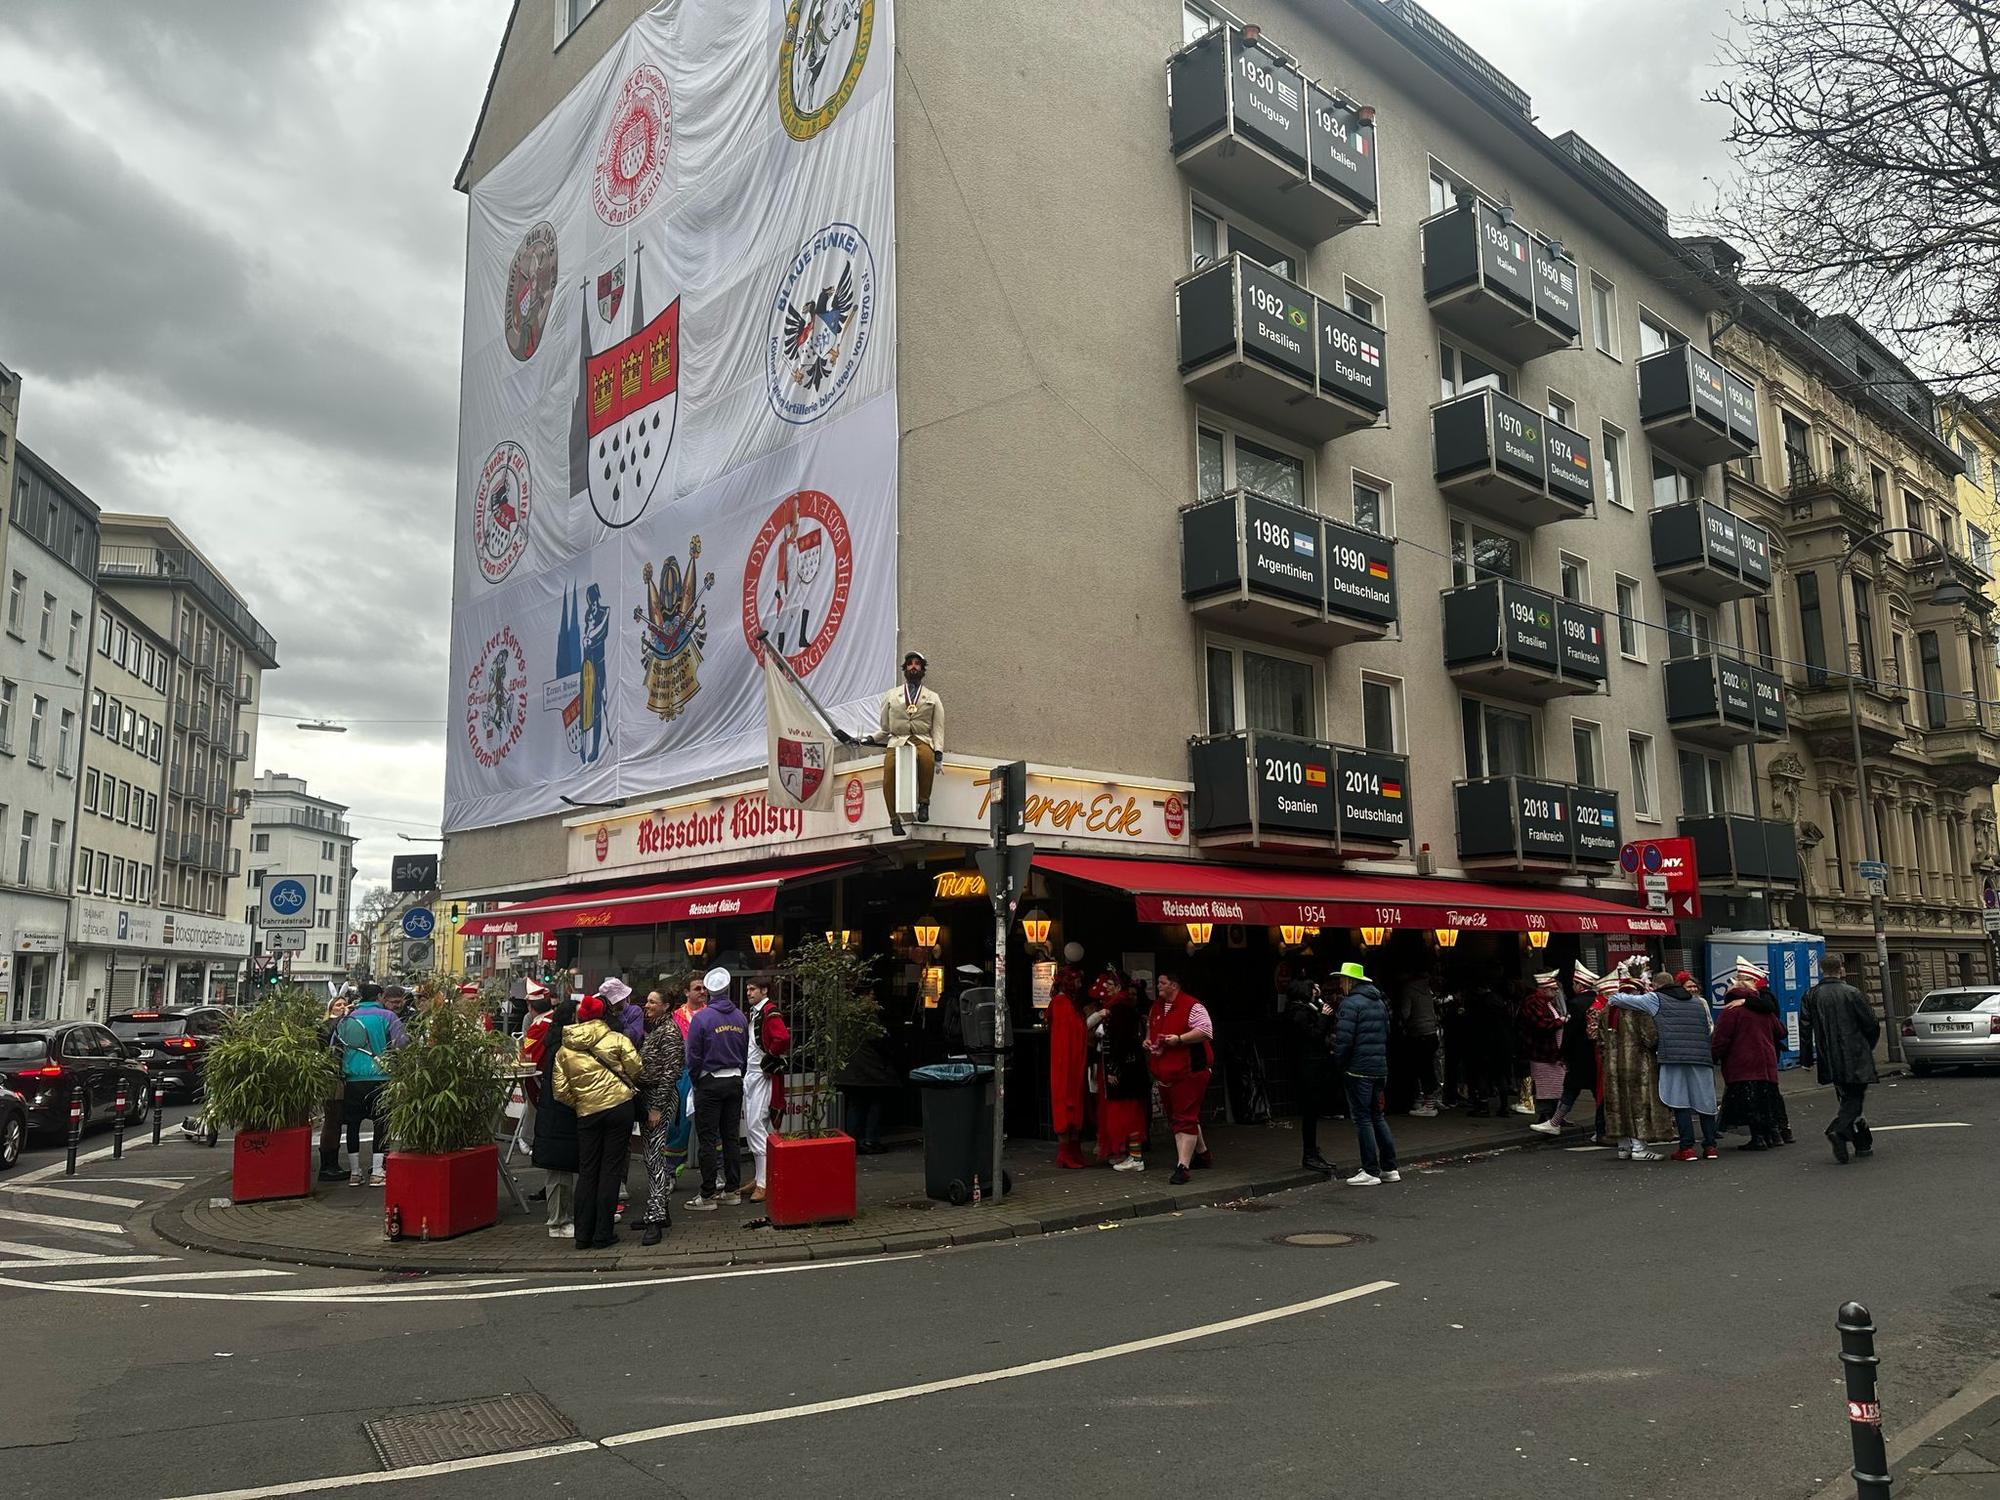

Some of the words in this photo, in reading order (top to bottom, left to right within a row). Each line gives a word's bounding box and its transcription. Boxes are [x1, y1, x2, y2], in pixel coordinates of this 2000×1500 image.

[1238, 56, 1274, 94] 1930
[1249, 92, 1290, 130] Uruguay
[1315, 108, 1347, 143] 1934
[1330, 146, 1357, 172] Italien
[1485, 223, 1509, 251] 1938
[777, 250, 812, 312] BLAUE
[814, 232, 859, 258] FUNKEN
[1497, 255, 1517, 276] Italien
[1537, 258, 1558, 284] 1950
[1249, 285, 1284, 320] 1962
[1544, 285, 1569, 311] Uruguay
[1258, 321, 1301, 354] Brasilien
[1325, 324, 1358, 357] 1966
[784, 400, 818, 415] Artillerie
[853, 331, 865, 356] von
[860, 295, 871, 325] 1870
[1335, 360, 1372, 387] England
[1694, 363, 1711, 384] 1954
[1695, 384, 1723, 408] Deutschland
[1498, 411, 1522, 437] 1970
[1505, 441, 1534, 464] Brasilien
[1550, 438, 1572, 461] 1974
[1551, 463, 1589, 488] Deutschland
[1254, 518, 1290, 549] 1986
[1707, 517, 1724, 537] 1978
[1710, 540, 1736, 558] Argentinien
[1741, 534, 1756, 552] 1982
[1257, 554, 1314, 583] Argentinien
[1332, 545, 1366, 572] 1990
[751, 521, 776, 568] KKG
[790, 554, 849, 677] ÜRGERWEHR
[828, 507, 846, 546] 1903
[1334, 577, 1390, 604] Deutschland
[1510, 601, 1535, 624] 1994
[1517, 632, 1547, 650] Brasilien
[1562, 619, 1586, 640] 1998
[1567, 646, 1600, 665] Frankreich
[1722, 671, 1740, 689] 2002
[1756, 682, 1773, 699] 2006
[1265, 758, 1302, 784] 2010
[1345, 770, 1379, 795] 2014
[973, 776, 1086, 830] Terer
[1085, 793, 1142, 836] Eck
[1277, 796, 1318, 813] Spanien
[1346, 805, 1403, 824] Deutschland
[1523, 798, 1549, 819] 2018
[1576, 805, 1600, 825] 2022
[637, 804, 726, 855] Reissdorf
[1528, 828, 1565, 843] Frankreich
[1580, 834, 1616, 848] Argentinien
[396, 863, 429, 882] sky
[689, 901, 718, 915] Reissdorf
[719, 899, 741, 913] Kölsch
[1163, 900, 1209, 918] Reissdorf
[1212, 900, 1243, 920] Kölsch
[1298, 905, 1326, 923] 1954
[1376, 908, 1401, 924] 1974
[119, 914, 127, 937] P
[262, 917, 312, 925] Fahrradstraße
[1525, 914, 1546, 929] 1990
[1579, 916, 1599, 930] 2014
